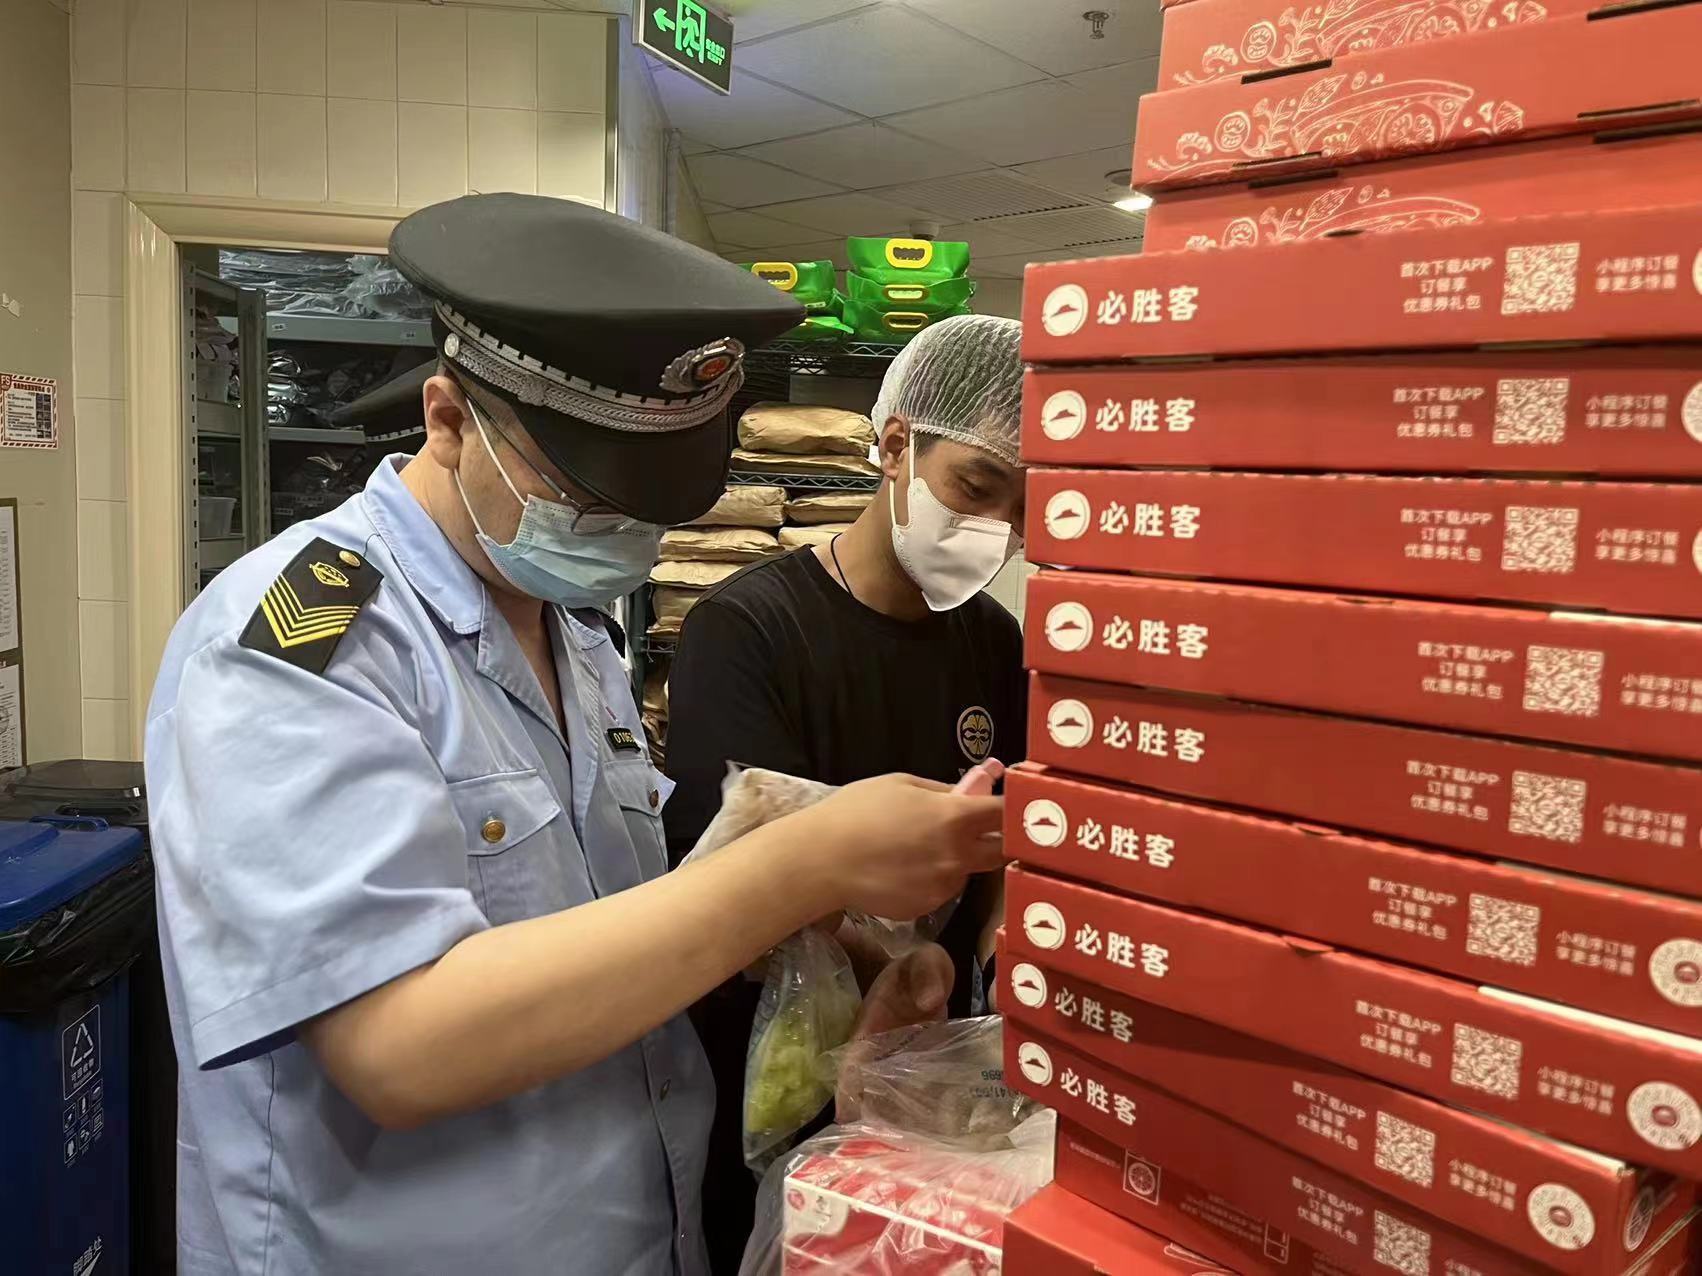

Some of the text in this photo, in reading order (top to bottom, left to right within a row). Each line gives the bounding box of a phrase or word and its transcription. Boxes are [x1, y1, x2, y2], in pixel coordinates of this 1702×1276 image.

[1097, 286, 1198, 324] 必胜客
[1096, 398, 1195, 431] 必胜客
[1100, 501, 1200, 538] 必胜客
[1103, 616, 1208, 658] 必胜客
[1103, 716, 1204, 762] 必胜客
[1077, 818, 1174, 868] 必胜客
[1075, 924, 1168, 977] 必胜客
[1055, 988, 1133, 1042] 必胜客
[1061, 1068, 1136, 1125] 必胜客
